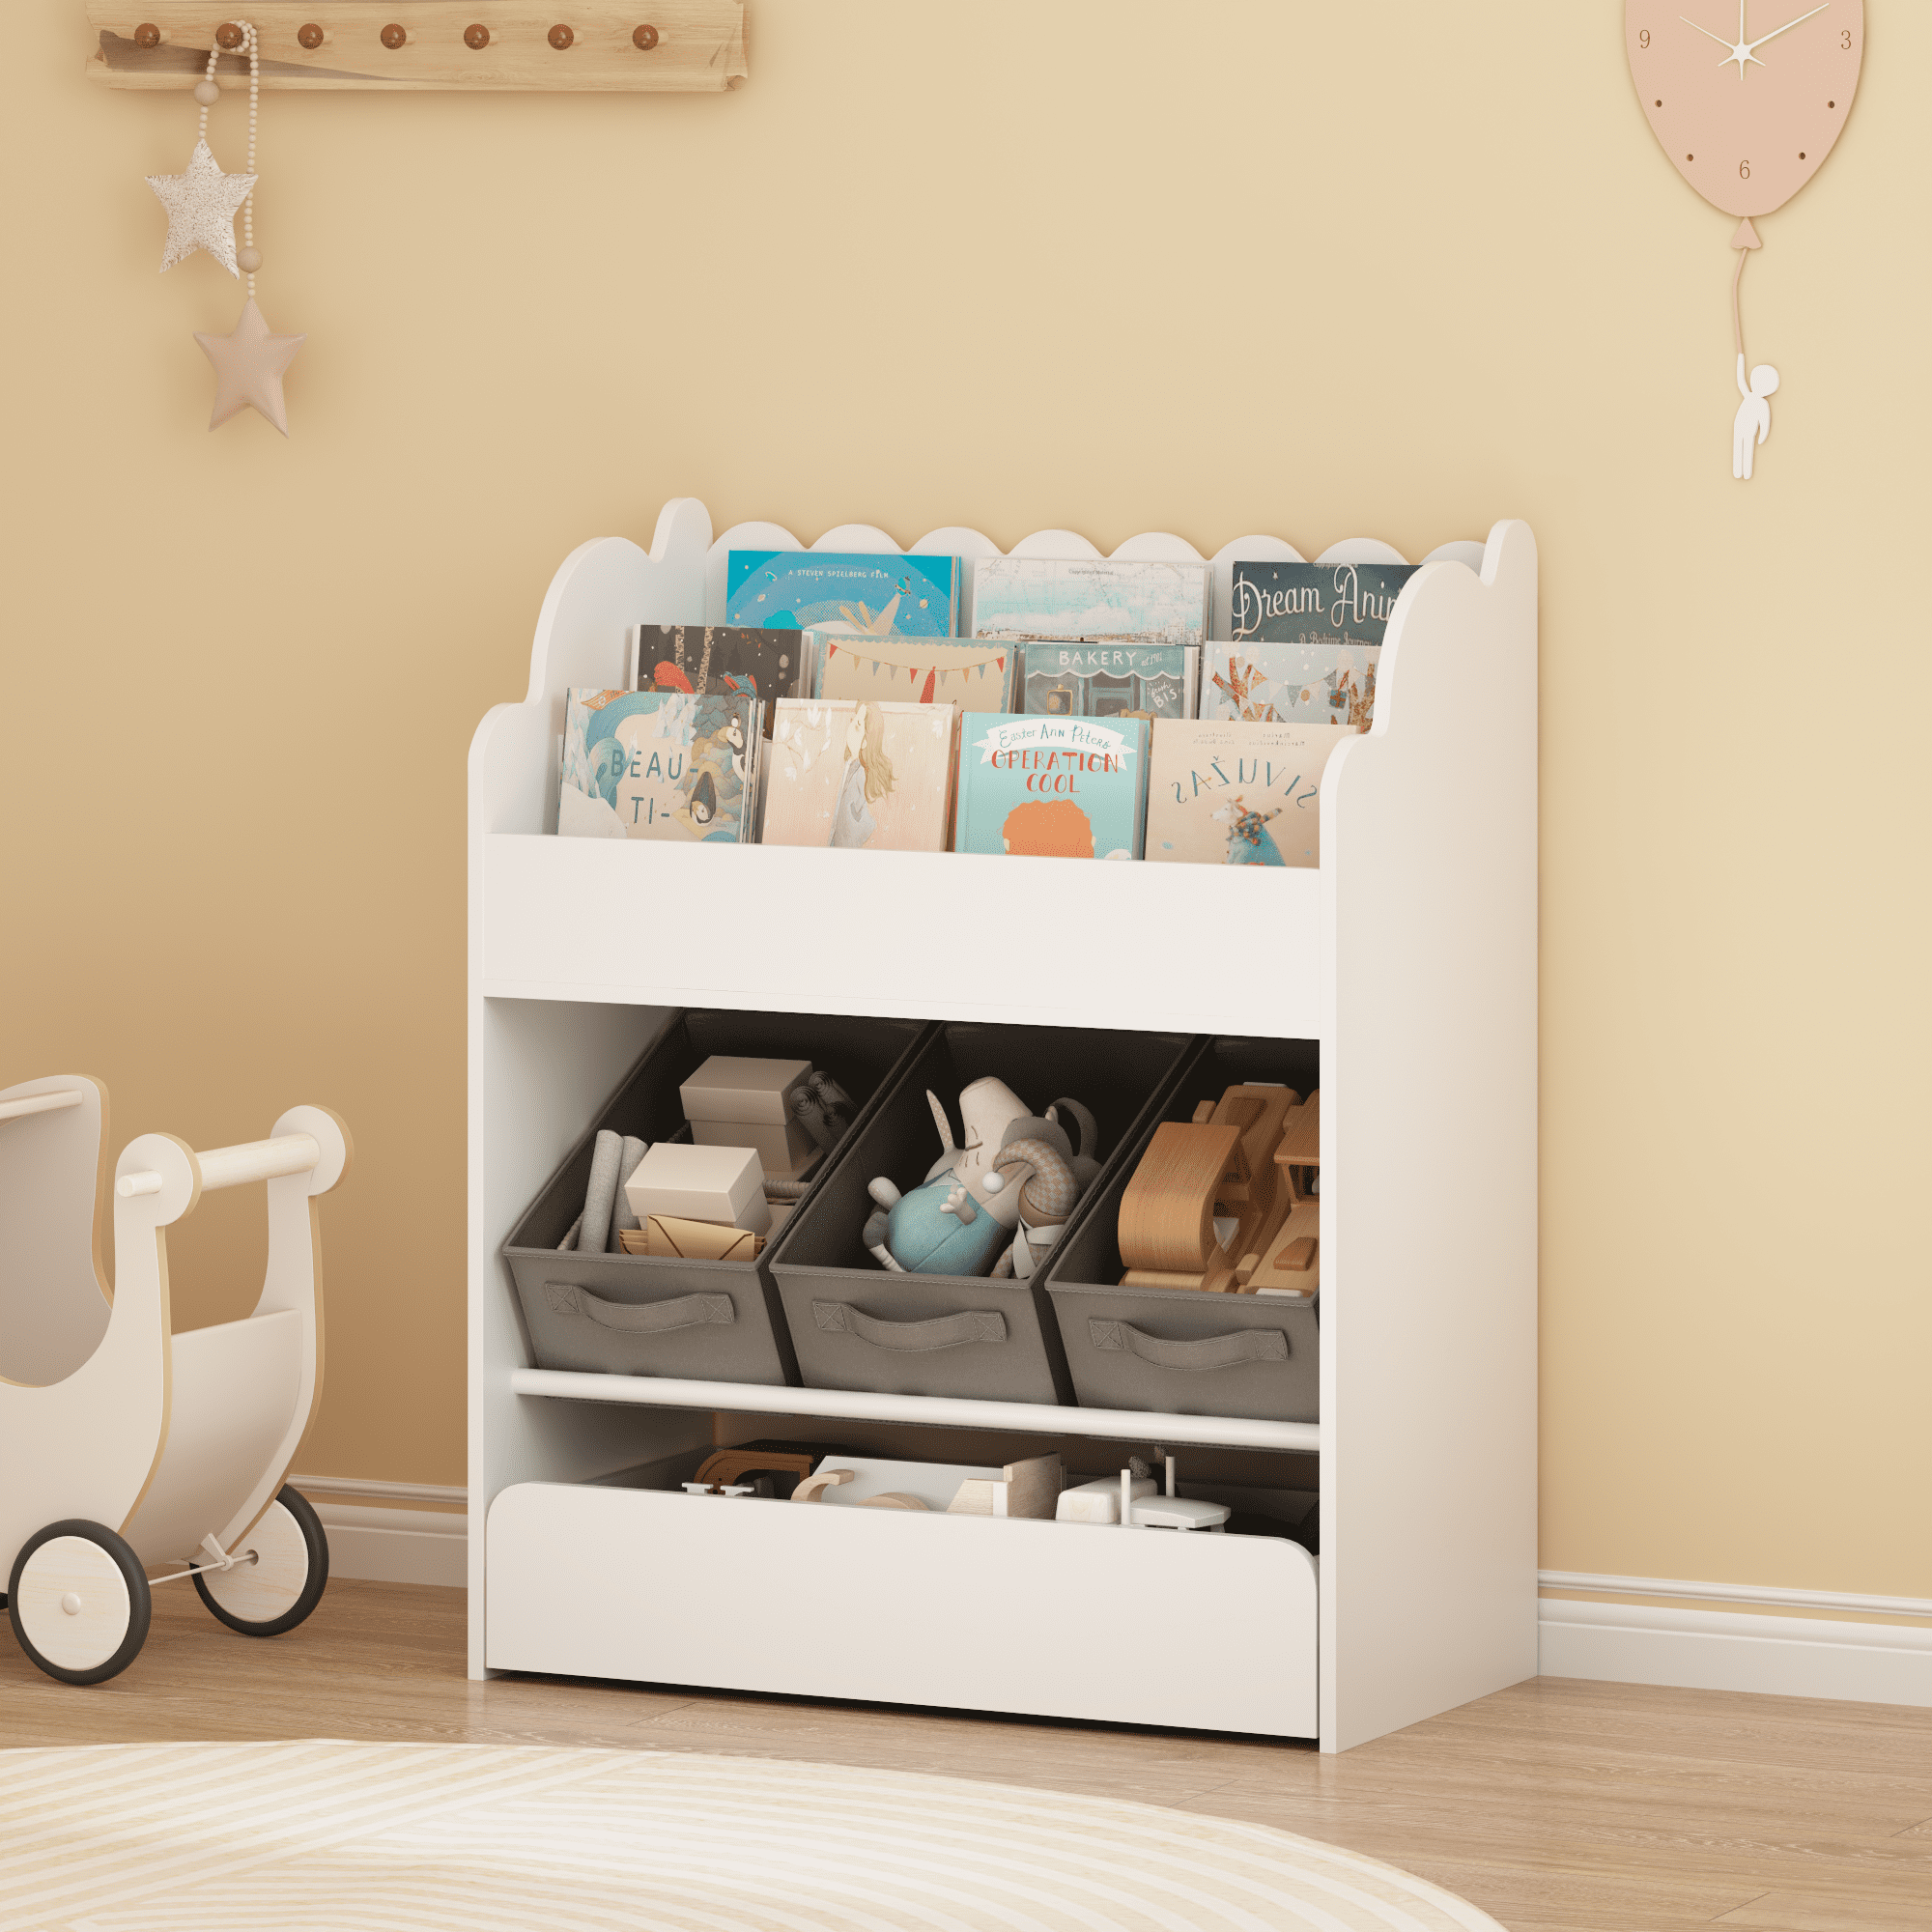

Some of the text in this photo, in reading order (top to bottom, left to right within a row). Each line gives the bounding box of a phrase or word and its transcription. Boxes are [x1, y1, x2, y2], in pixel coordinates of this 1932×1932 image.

[1639, 29, 1651, 49] 9
[1840, 30, 1852, 49] 3
[1739, 159, 1750, 180] 6
[870, 569, 889, 579] FILM
[1232, 571, 1325, 642] Dream
[1059, 650, 1137, 667] BAKERY
[998, 724, 1112, 750] Easter Ann Peters
[991, 750, 1119, 774] OPERATION
[1026, 773, 1081, 793] COOL
[631, 796, 670, 824] TI-
